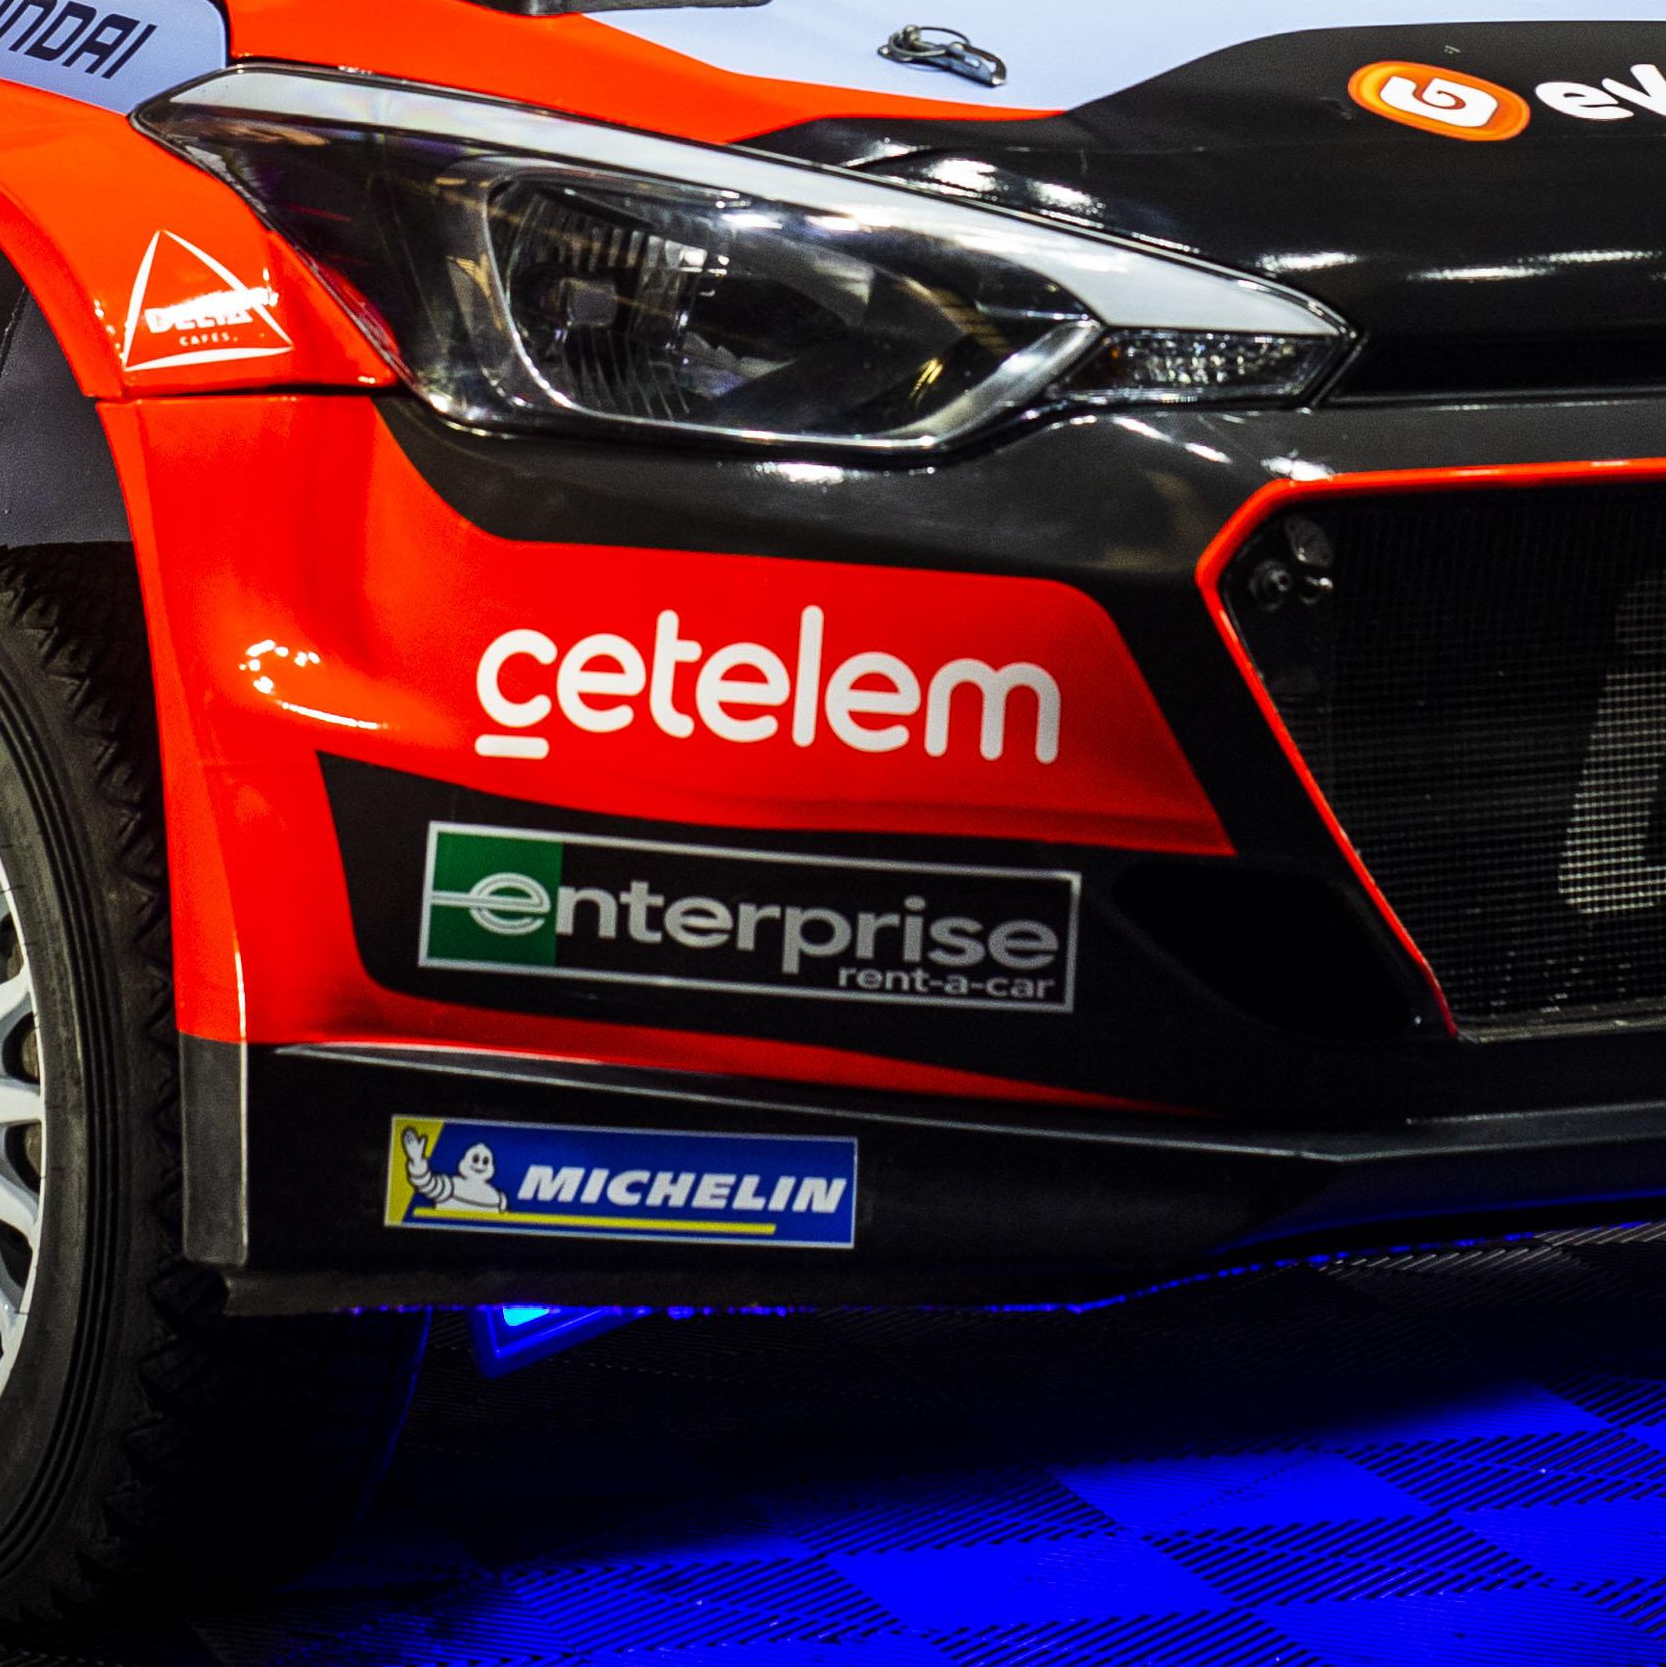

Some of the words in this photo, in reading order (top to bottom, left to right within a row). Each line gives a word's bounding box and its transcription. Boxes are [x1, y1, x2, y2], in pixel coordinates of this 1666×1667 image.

[475, 604, 1062, 765] cetelem
[467, 871, 1060, 976] enterprise
[838, 962, 1055, 1000] rent-a-car
[517, 1165, 847, 1216] MICHELIN
